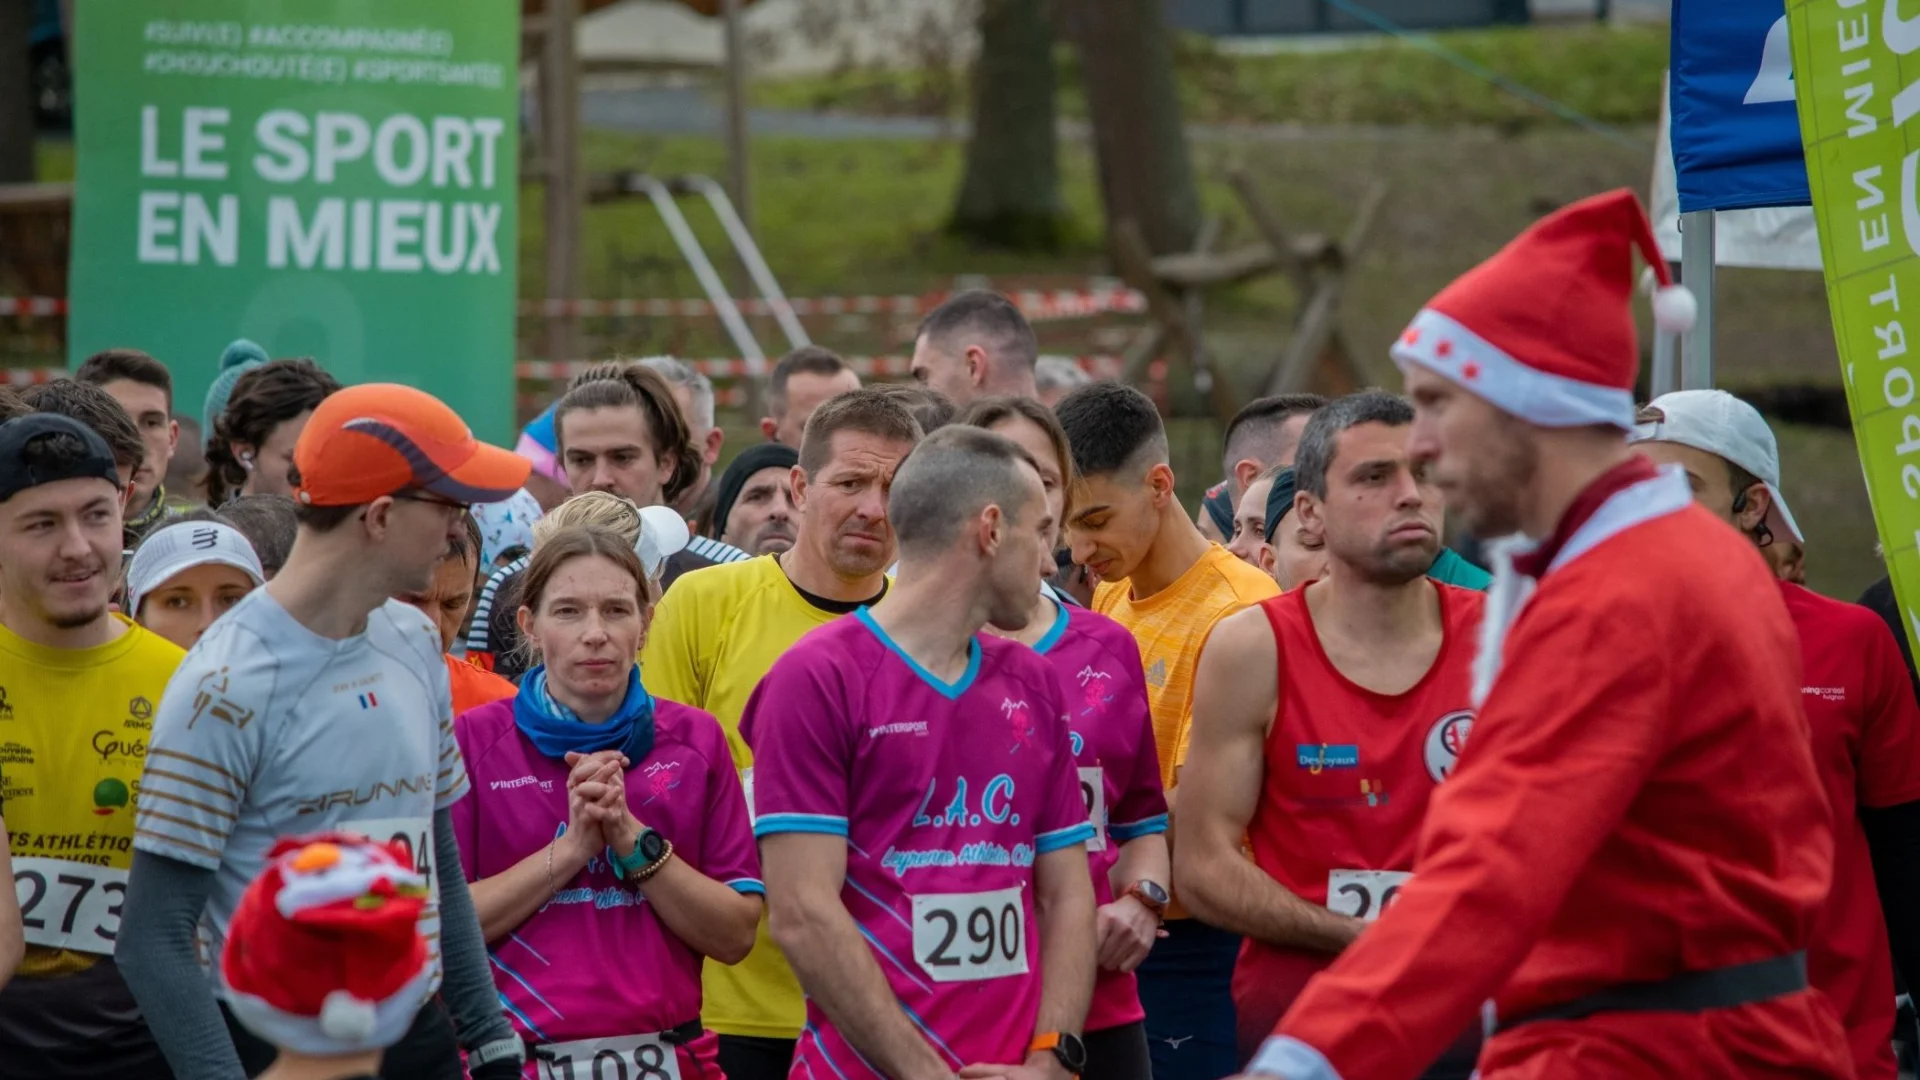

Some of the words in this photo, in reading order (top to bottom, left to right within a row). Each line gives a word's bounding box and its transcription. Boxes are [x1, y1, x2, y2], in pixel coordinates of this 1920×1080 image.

[141, 105, 231, 180] LE
[254, 109, 504, 188] SPORT
[137, 191, 239, 267] EN
[267, 196, 502, 273] MIEUX
[912, 773, 1021, 827] L.A.C.
[14, 869, 127, 940] 273
[924, 902, 1020, 966] 290
